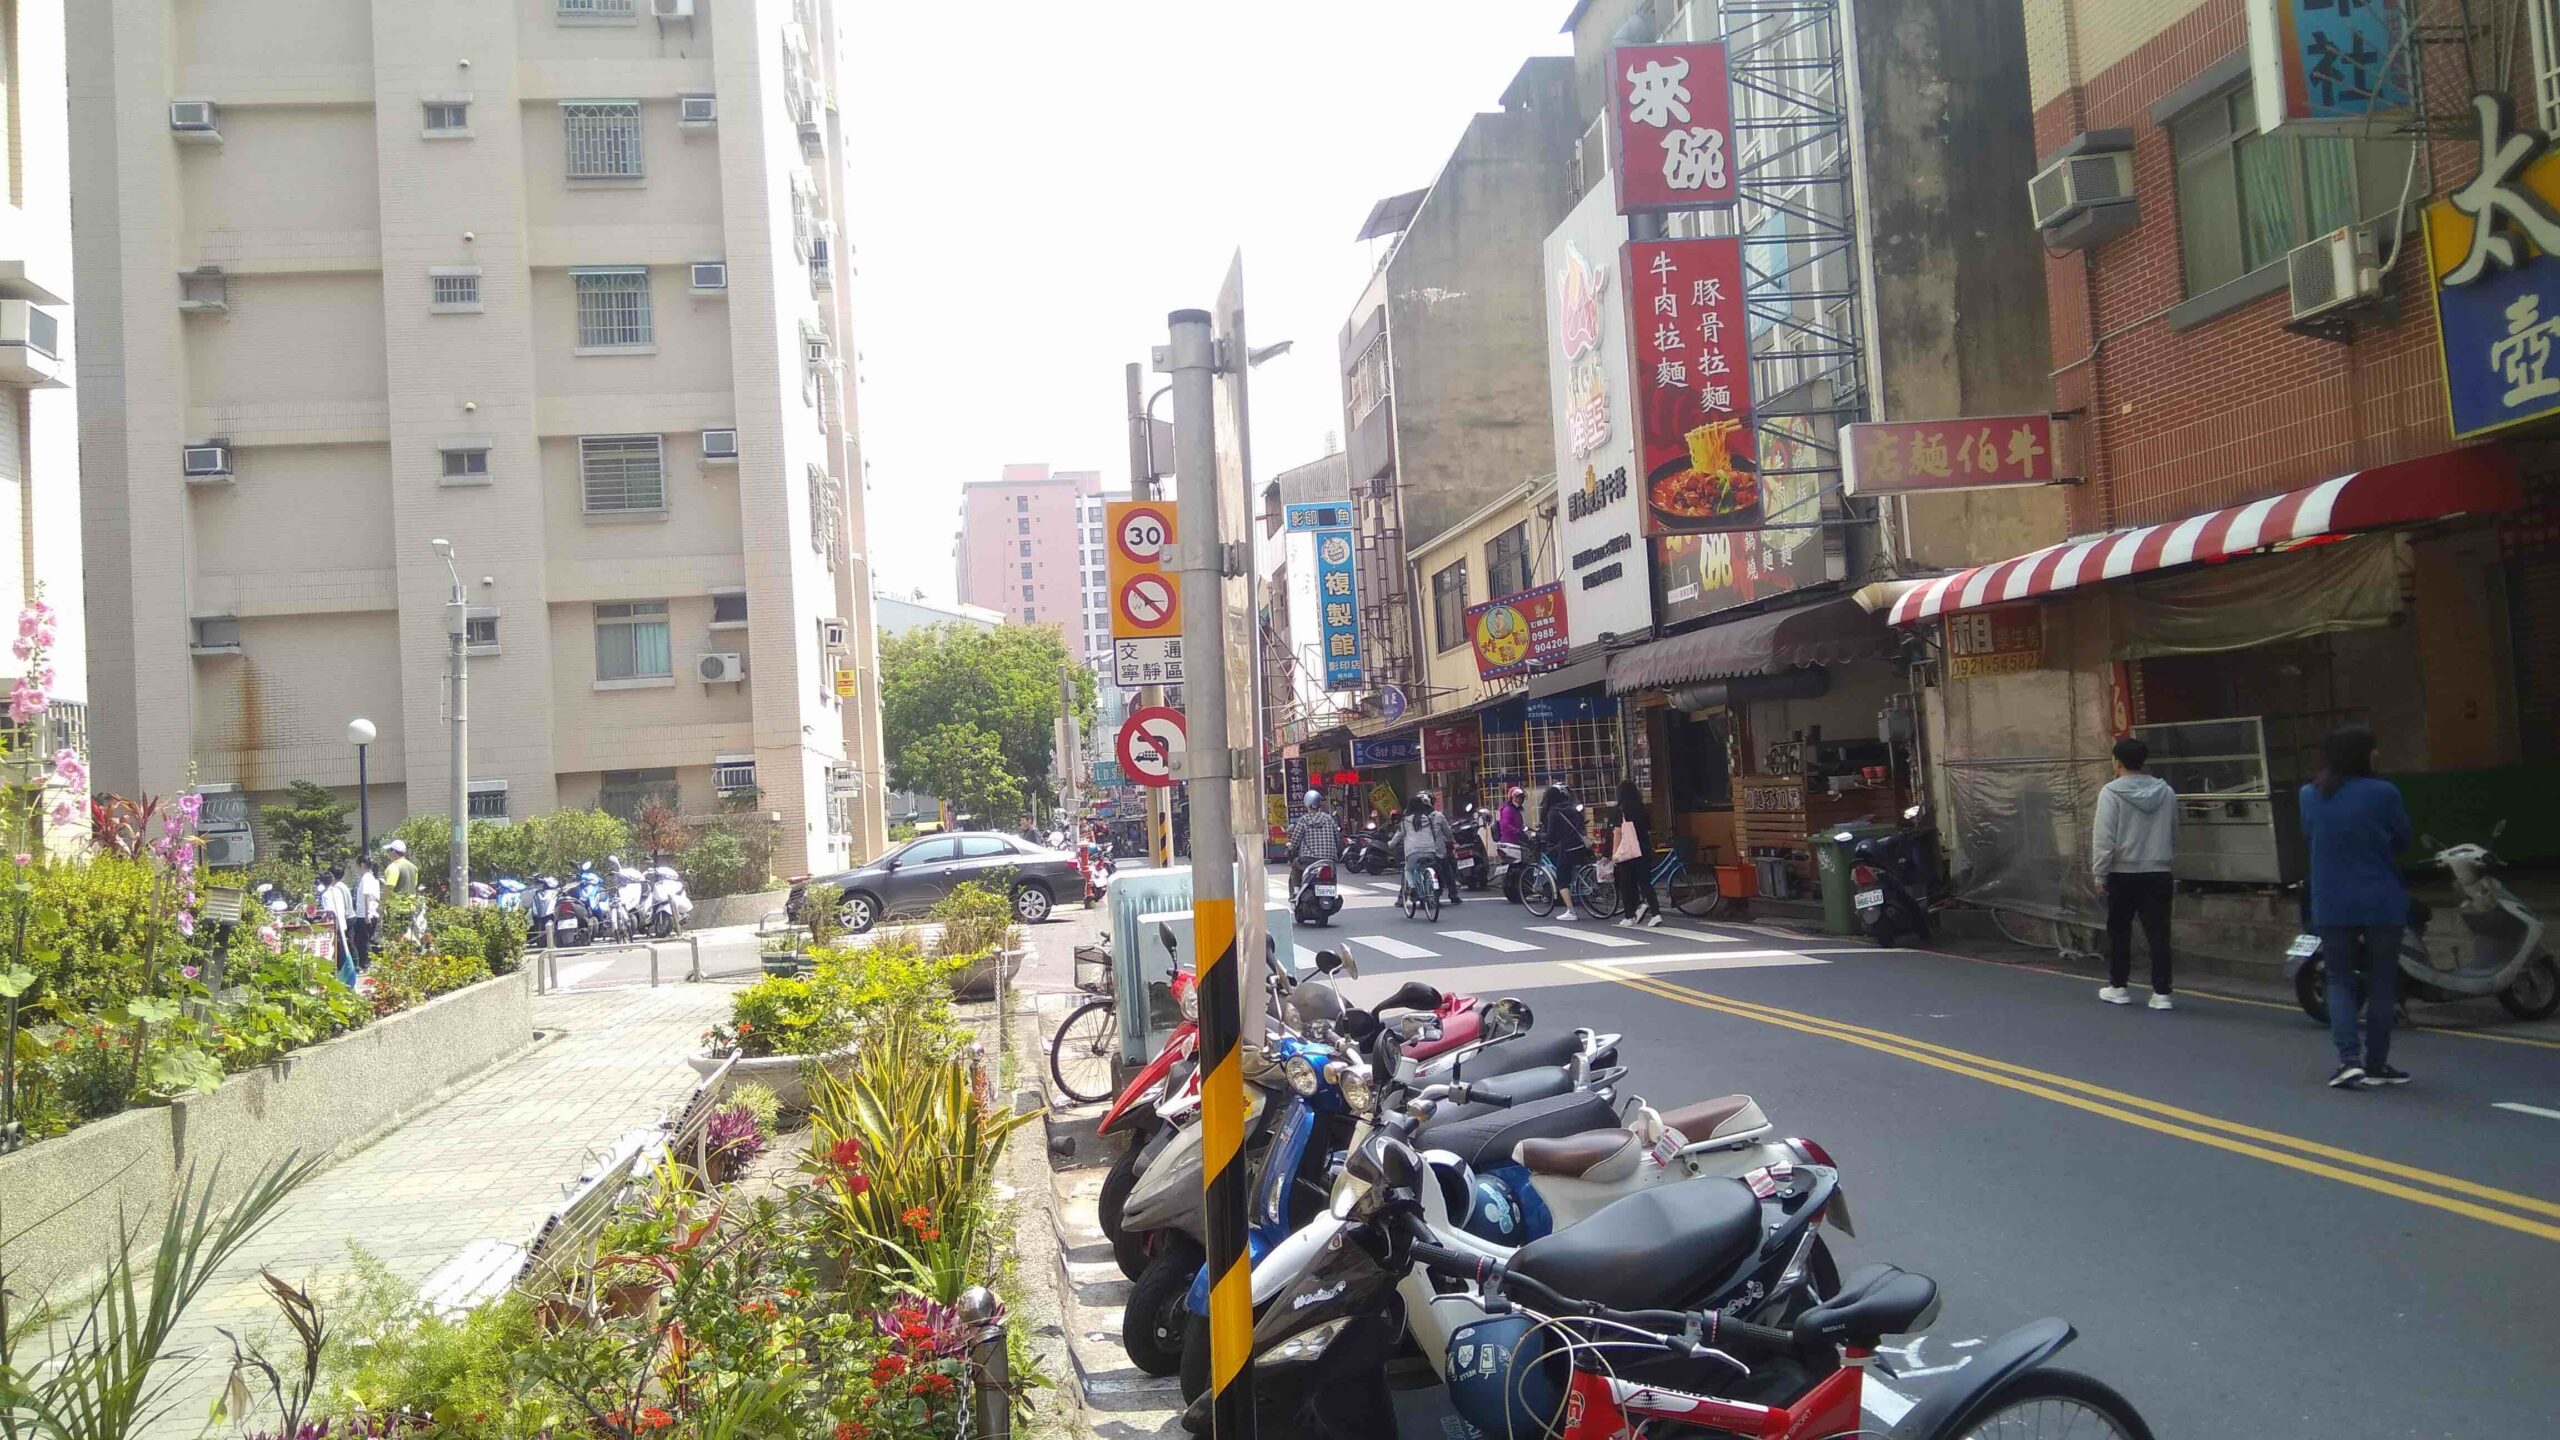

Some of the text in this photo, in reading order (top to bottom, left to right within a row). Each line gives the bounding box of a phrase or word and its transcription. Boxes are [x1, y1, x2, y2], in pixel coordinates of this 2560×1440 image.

[1650, 250, 1690, 389] 牛肉拉麵
[1690, 277, 1734, 414] 豚骨拉麵
[1128, 526, 1161, 546] 30
[1325, 571, 1356, 657] 複製館
[1531, 628, 1557, 641] 0988-
[1535, 636, 1569, 653] 904204
[1121, 662, 1184, 682] 寧靜區
